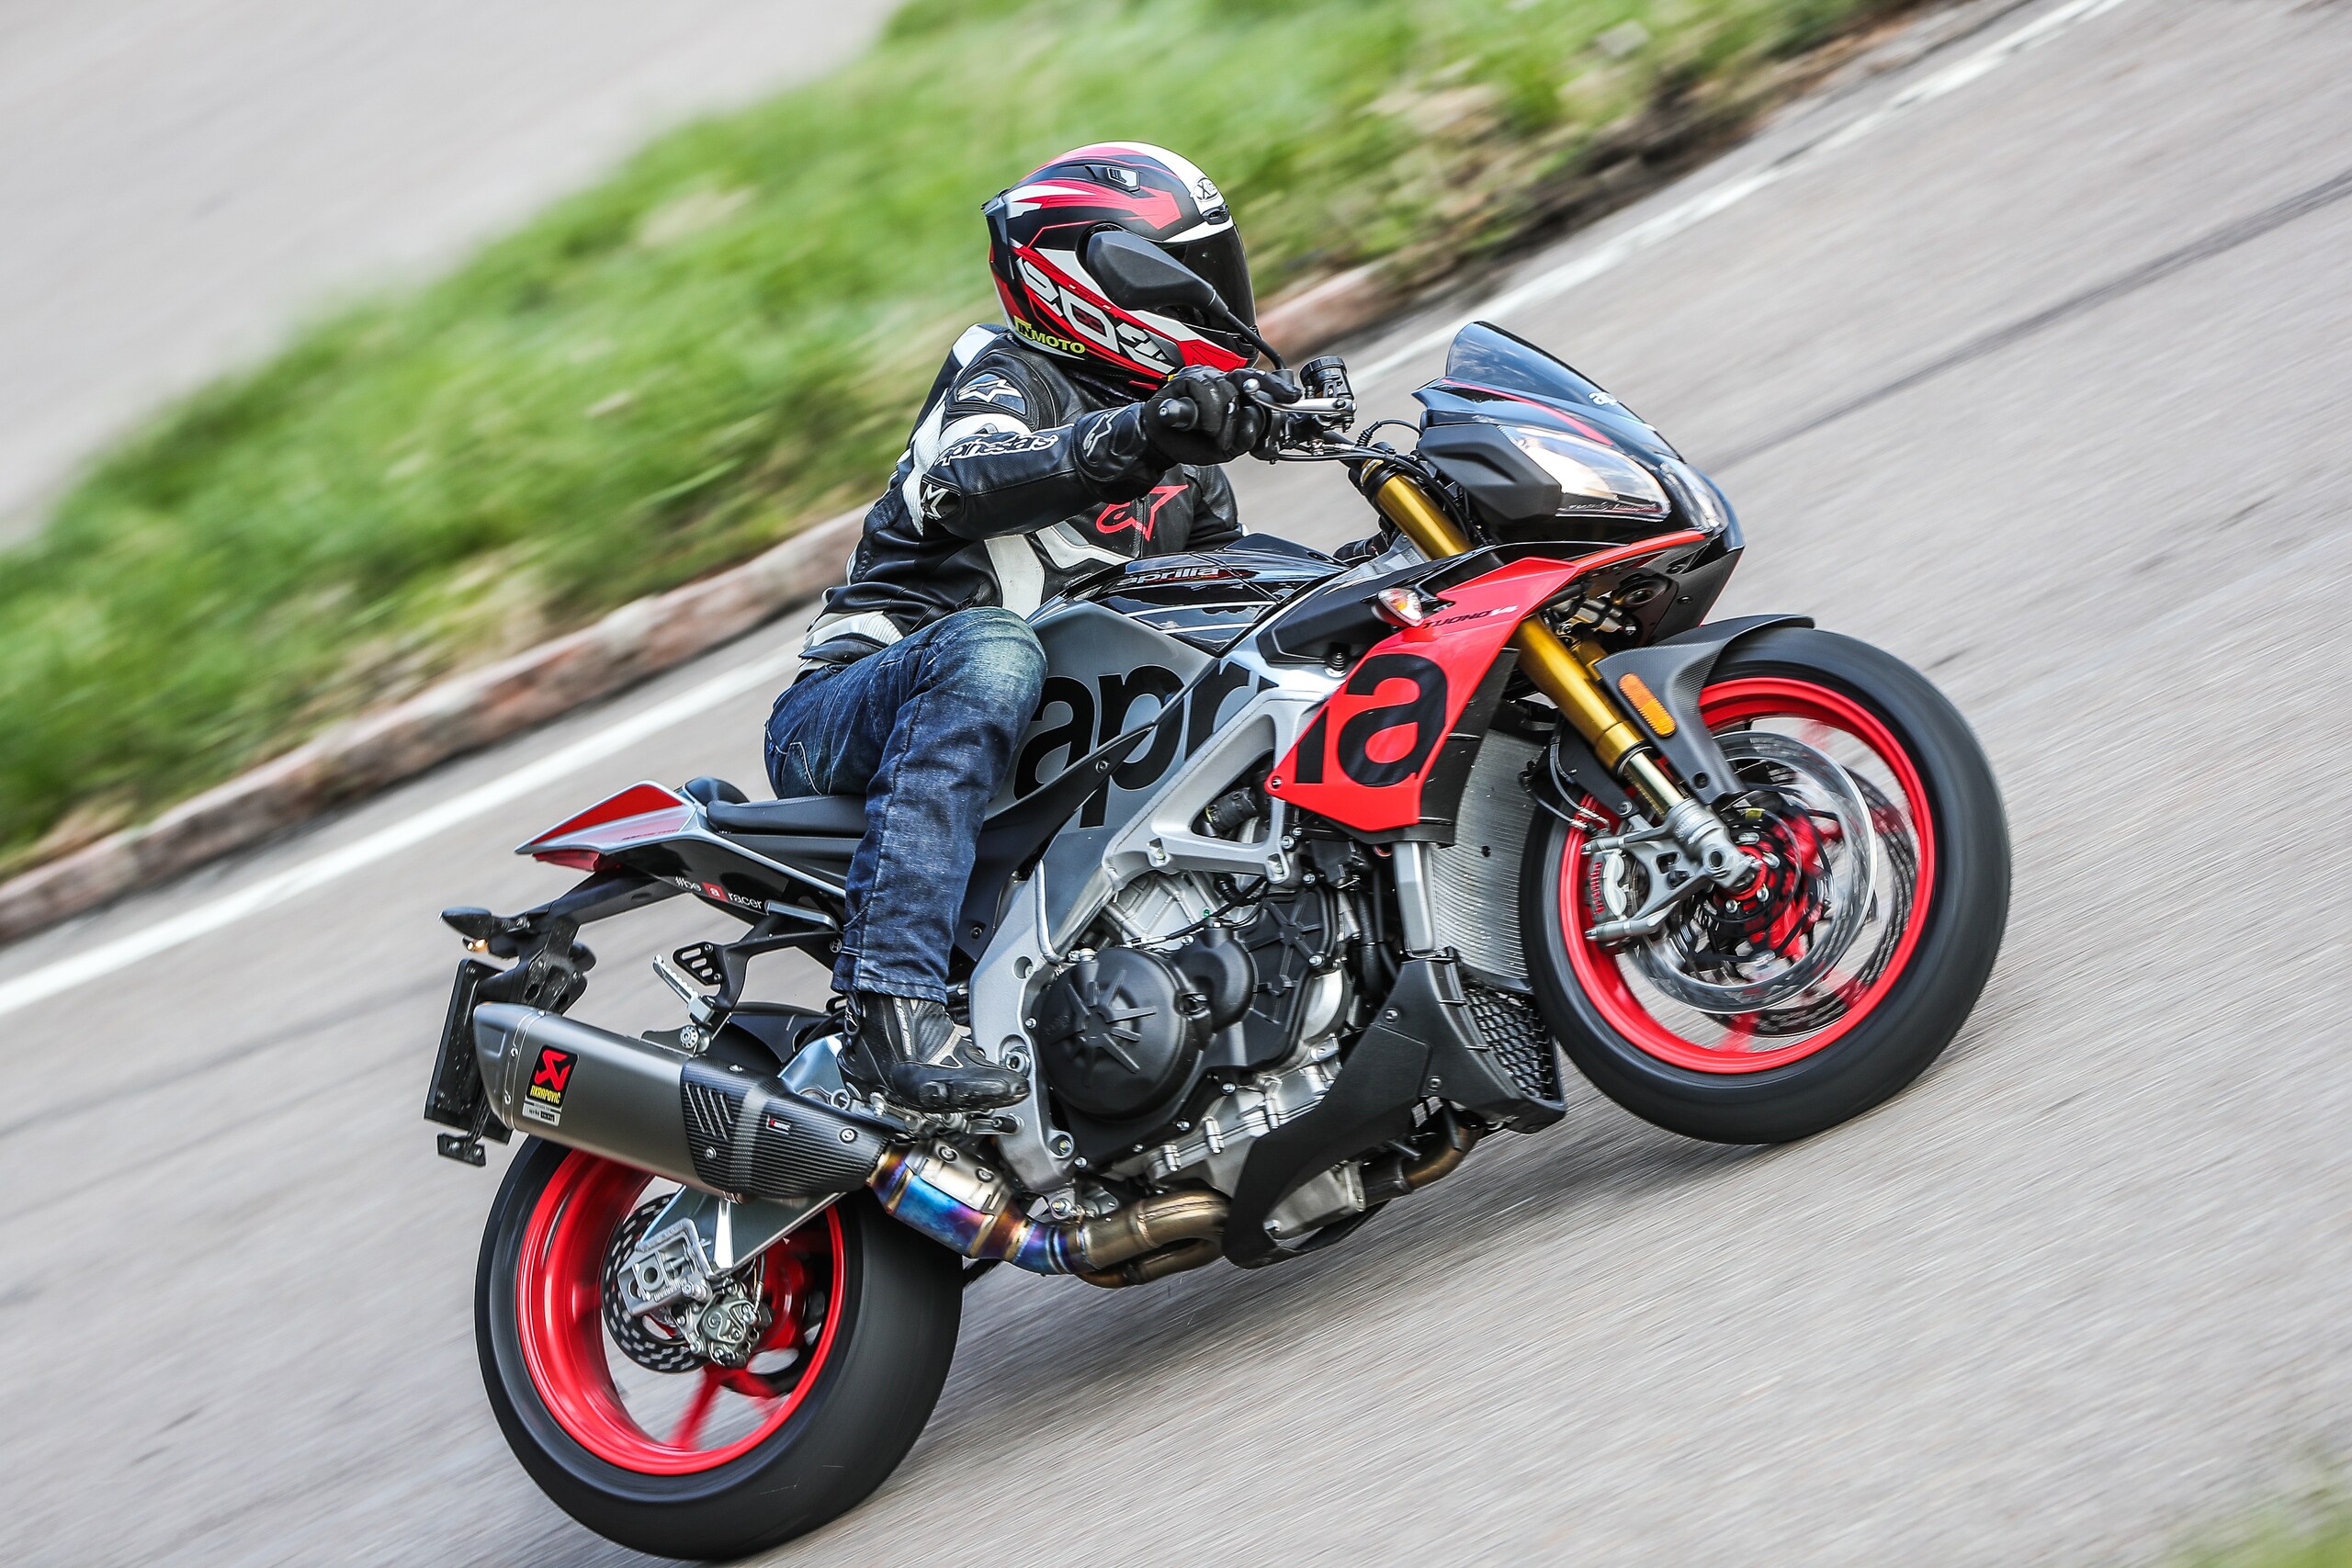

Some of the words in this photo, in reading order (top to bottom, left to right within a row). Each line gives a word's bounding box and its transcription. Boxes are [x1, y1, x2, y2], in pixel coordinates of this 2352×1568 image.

[1116, 567, 1220, 586] aprilia
[1422, 610, 1493, 629] TUONO
[1588, 861, 1606, 915] brembo
[728, 891, 763, 909] racer
